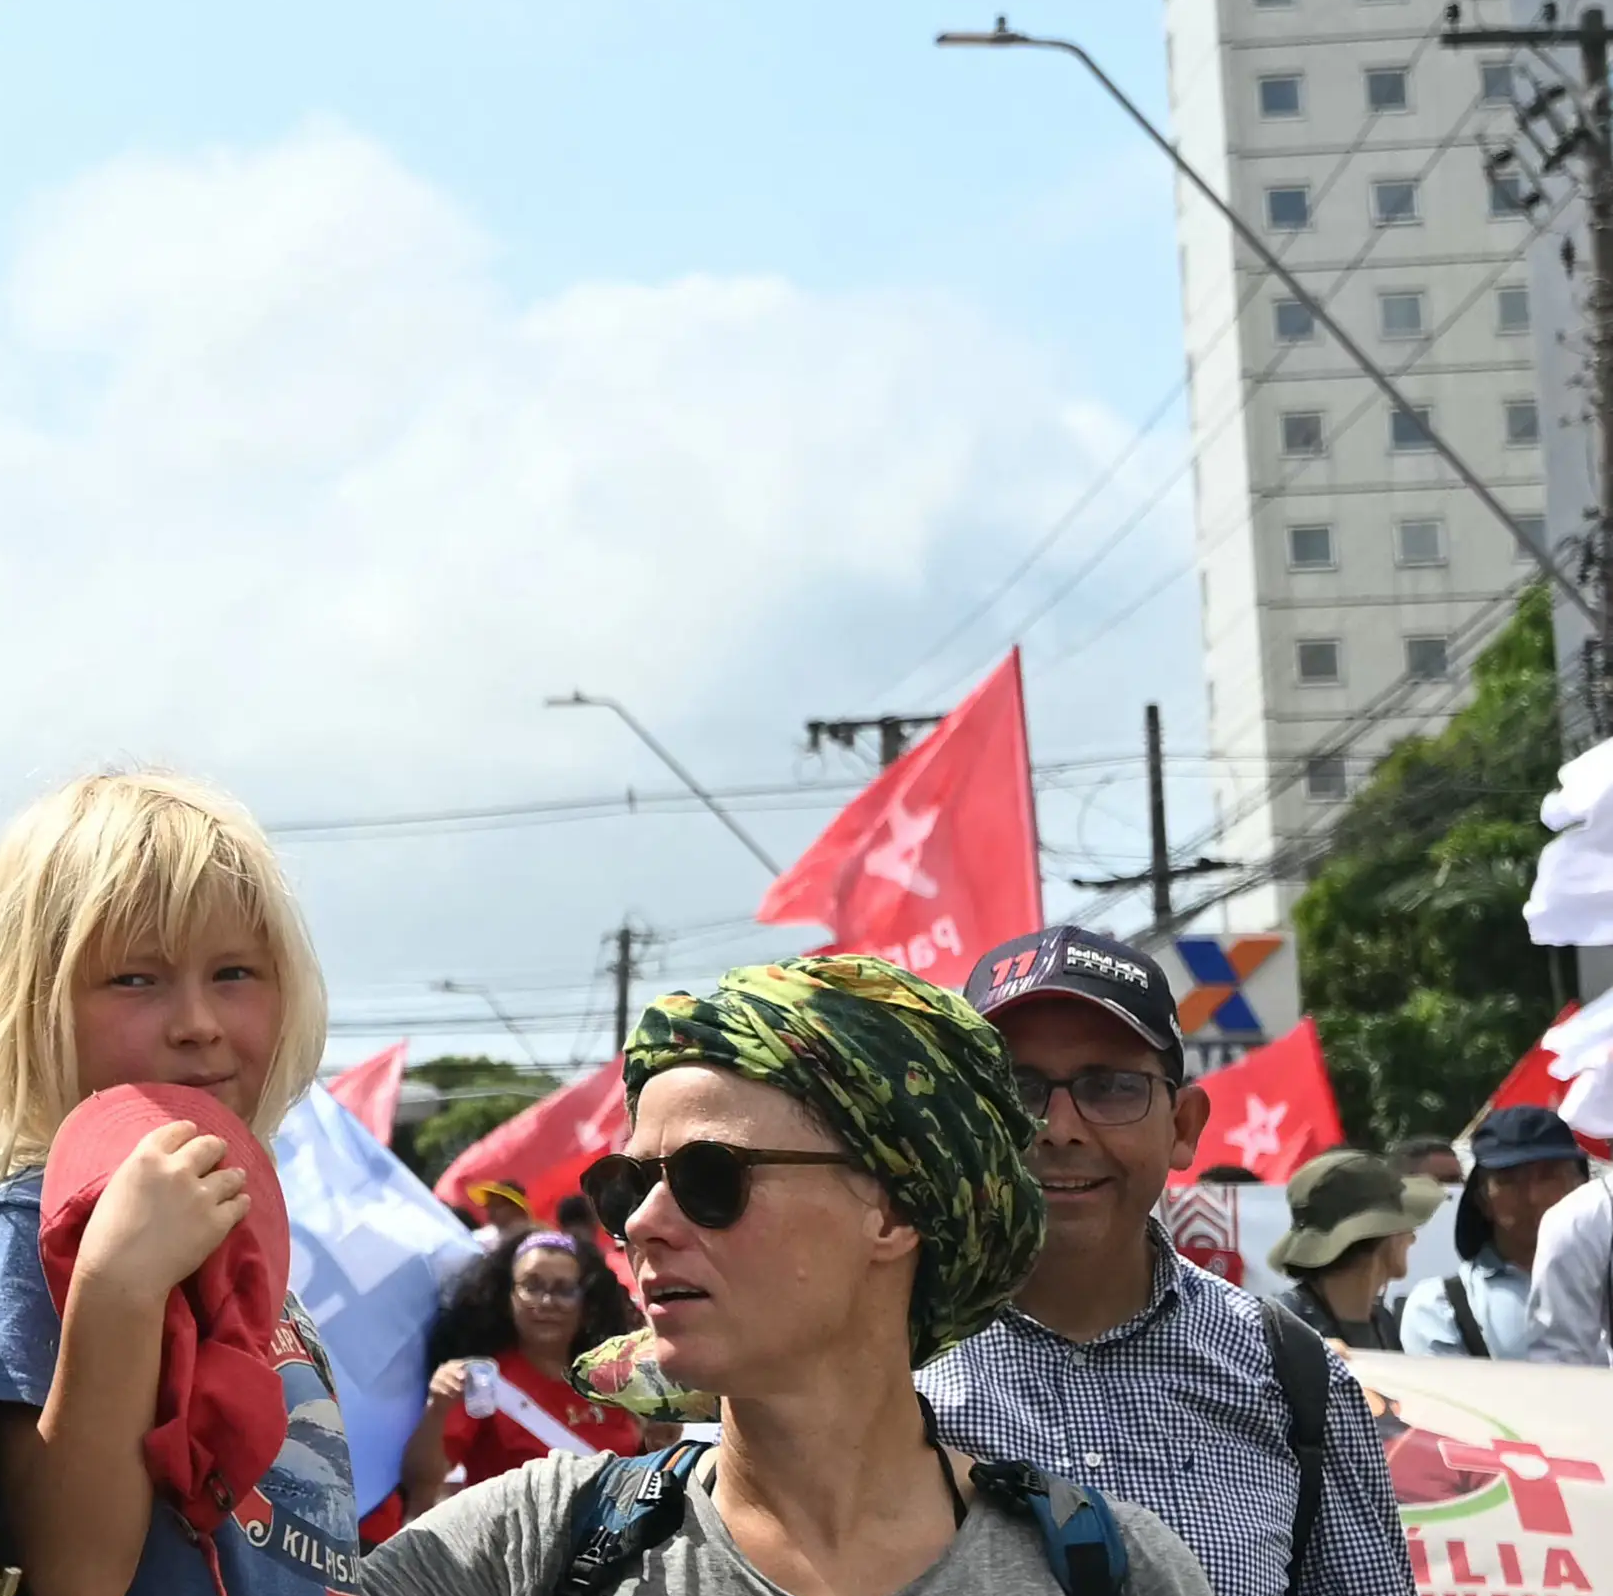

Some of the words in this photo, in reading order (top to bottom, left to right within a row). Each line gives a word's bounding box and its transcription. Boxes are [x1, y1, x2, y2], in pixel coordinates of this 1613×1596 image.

[991, 946, 1039, 988] 11
[1067, 945, 1090, 959] Red
[1091, 950, 1113, 965] Bull
[1067, 958, 1150, 989] RACING
